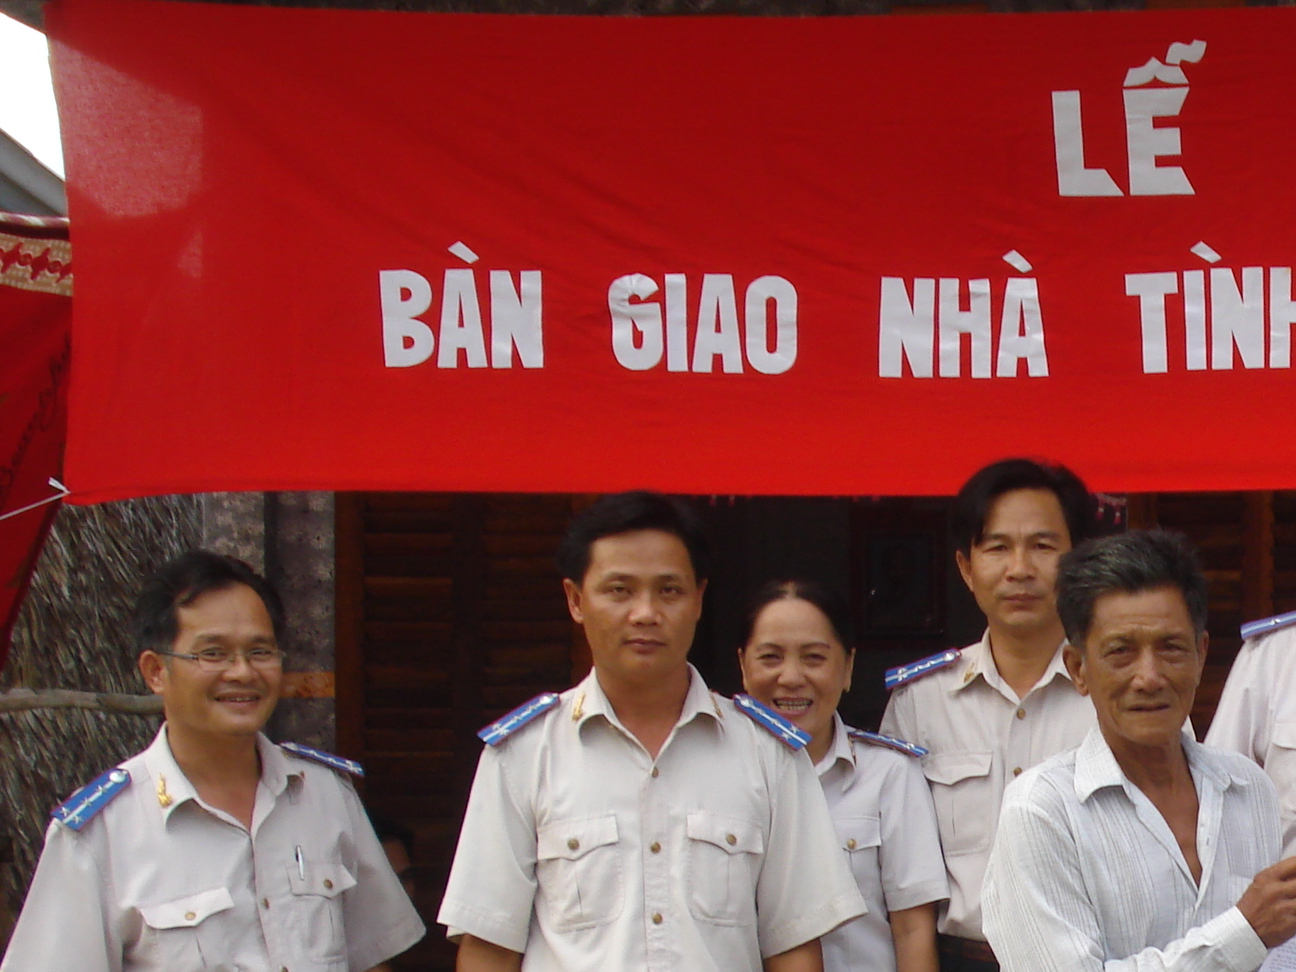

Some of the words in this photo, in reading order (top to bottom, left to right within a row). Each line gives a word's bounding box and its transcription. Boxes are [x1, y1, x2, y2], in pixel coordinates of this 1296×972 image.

[1051, 39, 1207, 196] LỄ
[380, 242, 543, 368] BÀN
[608, 274, 797, 374] GIAO
[879, 251, 1048, 377] NHÀ
